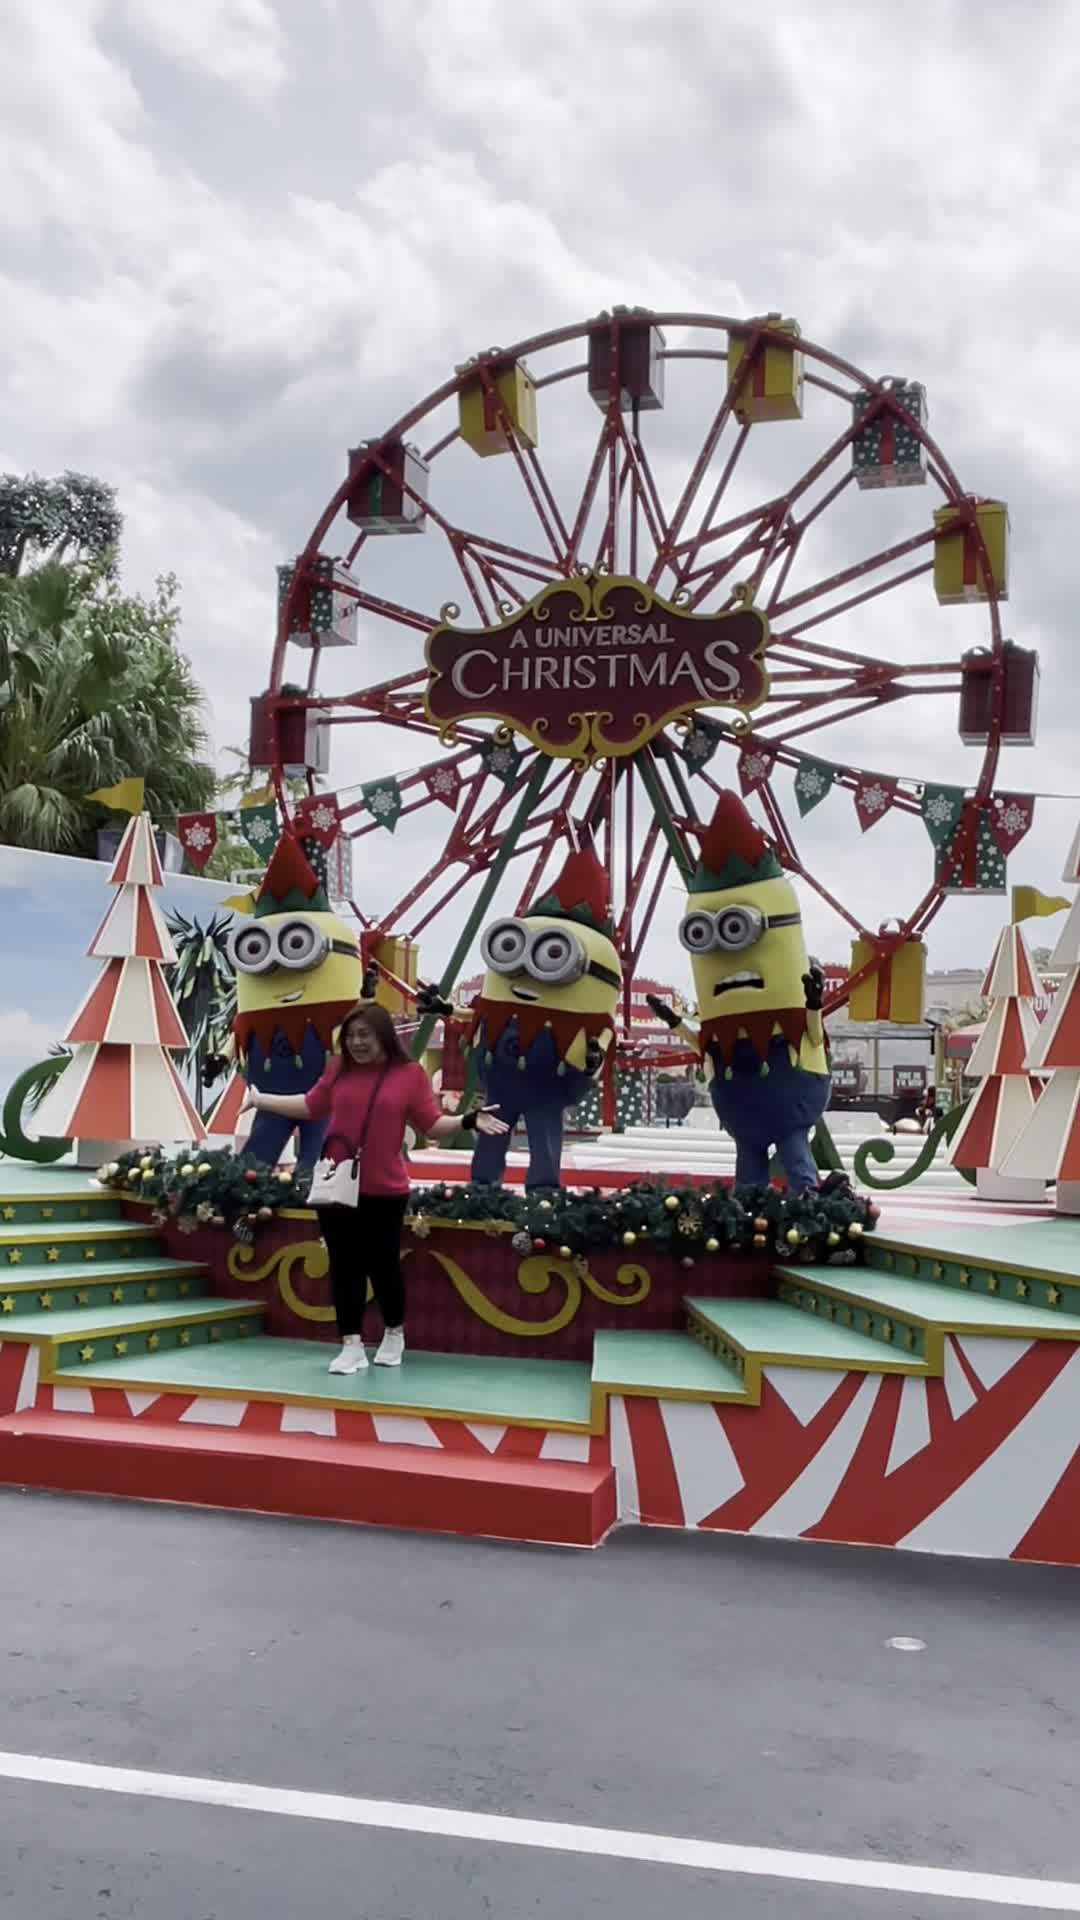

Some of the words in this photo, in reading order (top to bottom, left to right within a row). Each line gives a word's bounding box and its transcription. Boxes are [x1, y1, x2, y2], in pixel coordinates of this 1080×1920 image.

[509, 628, 529, 649] A
[535, 623, 676, 649] UNIVERSAL
[451, 640, 741, 702] CHRISTMAS
